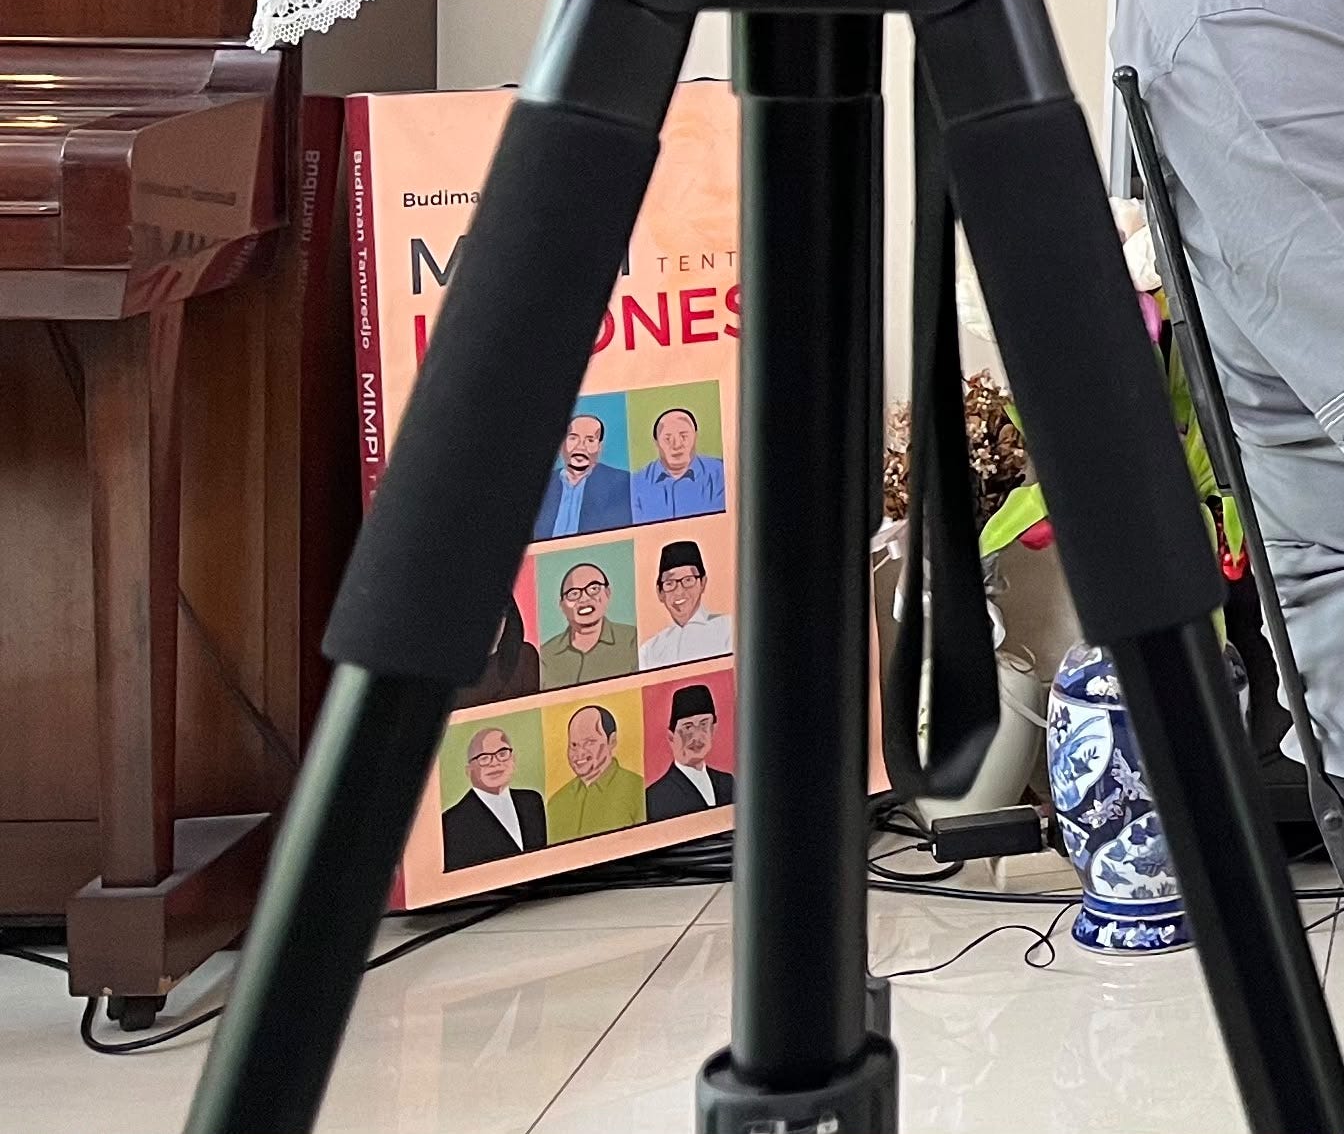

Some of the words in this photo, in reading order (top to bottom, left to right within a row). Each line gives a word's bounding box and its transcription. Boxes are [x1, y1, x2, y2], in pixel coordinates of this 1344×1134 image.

[353, 150, 367, 242] Budiman
[403, 190, 481, 208] Budima
[357, 247, 372, 349] Tanuredjo
[657, 251, 737, 274] TENT
[361, 372, 379, 463] MIMPI
